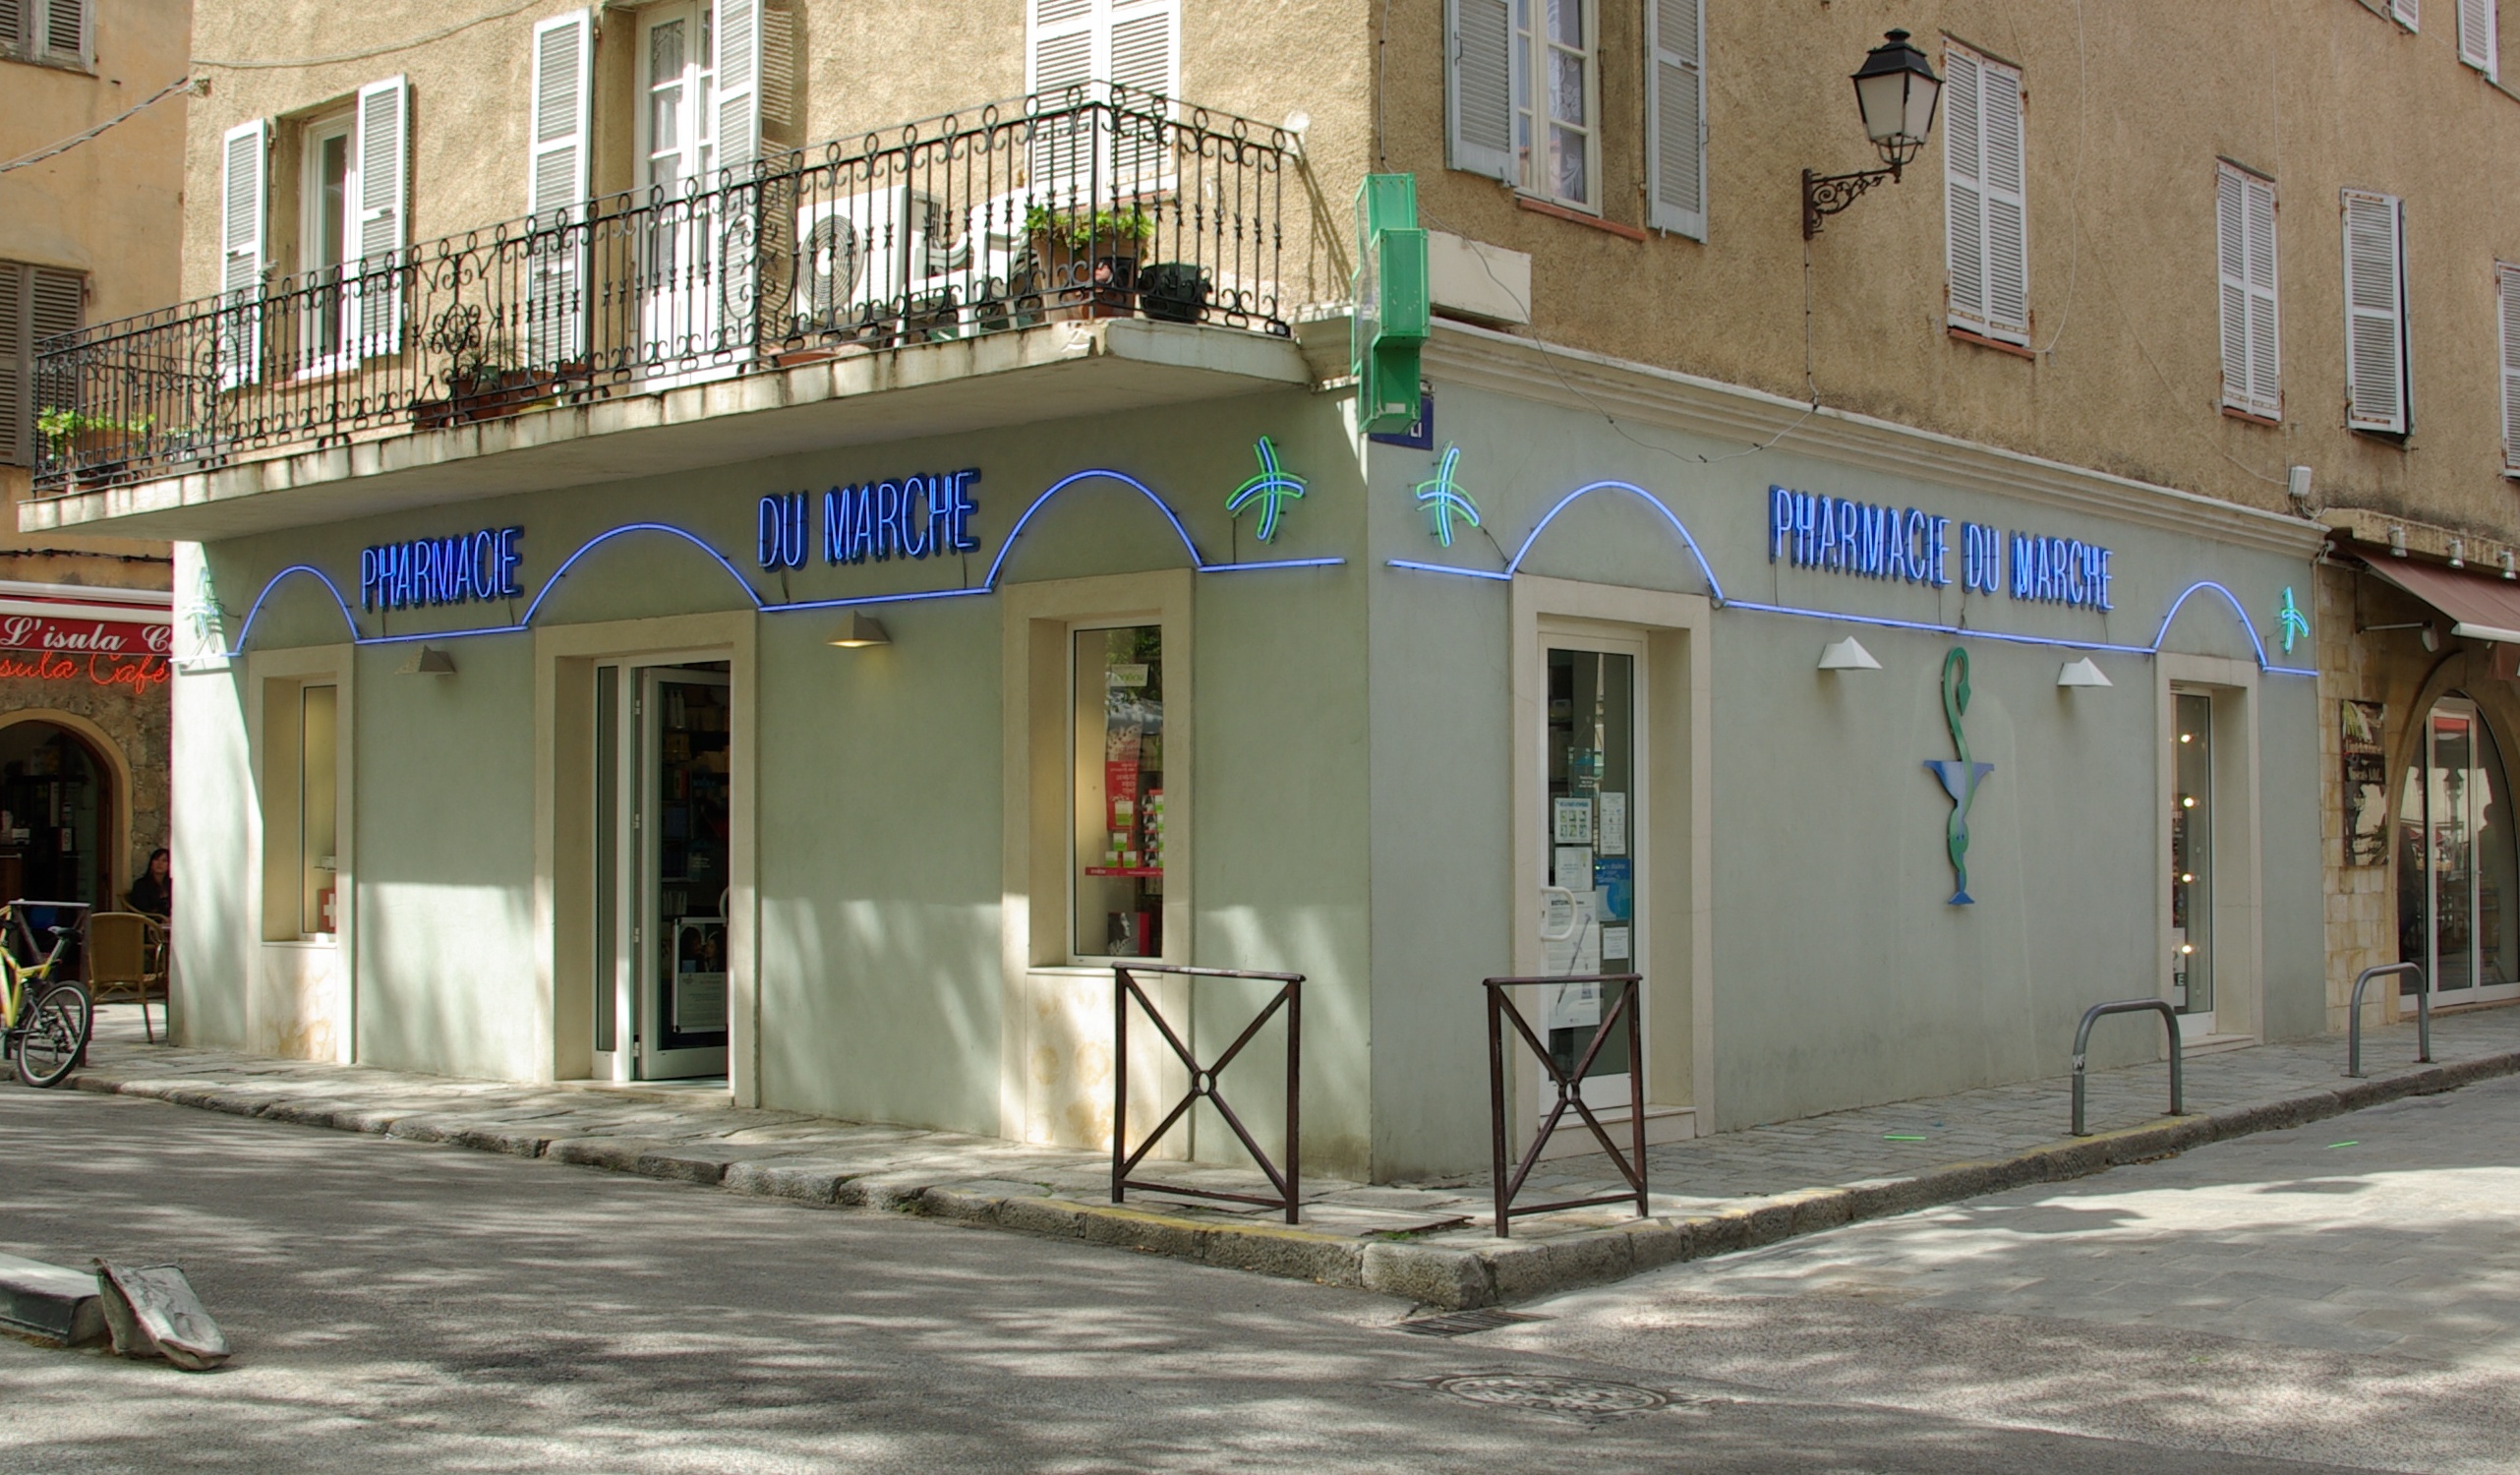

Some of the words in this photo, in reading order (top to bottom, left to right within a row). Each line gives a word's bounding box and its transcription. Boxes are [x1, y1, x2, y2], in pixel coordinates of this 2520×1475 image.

[758, 493, 809, 572] DU
[824, 467, 981, 566] MARCHE
[1769, 485, 1954, 590] PHARMACIE
[1961, 520, 2001, 596] DU
[2009, 529, 2115, 615] MARCHE
[361, 525, 524, 614] PHARMACIE
[142, 624, 173, 653] C
